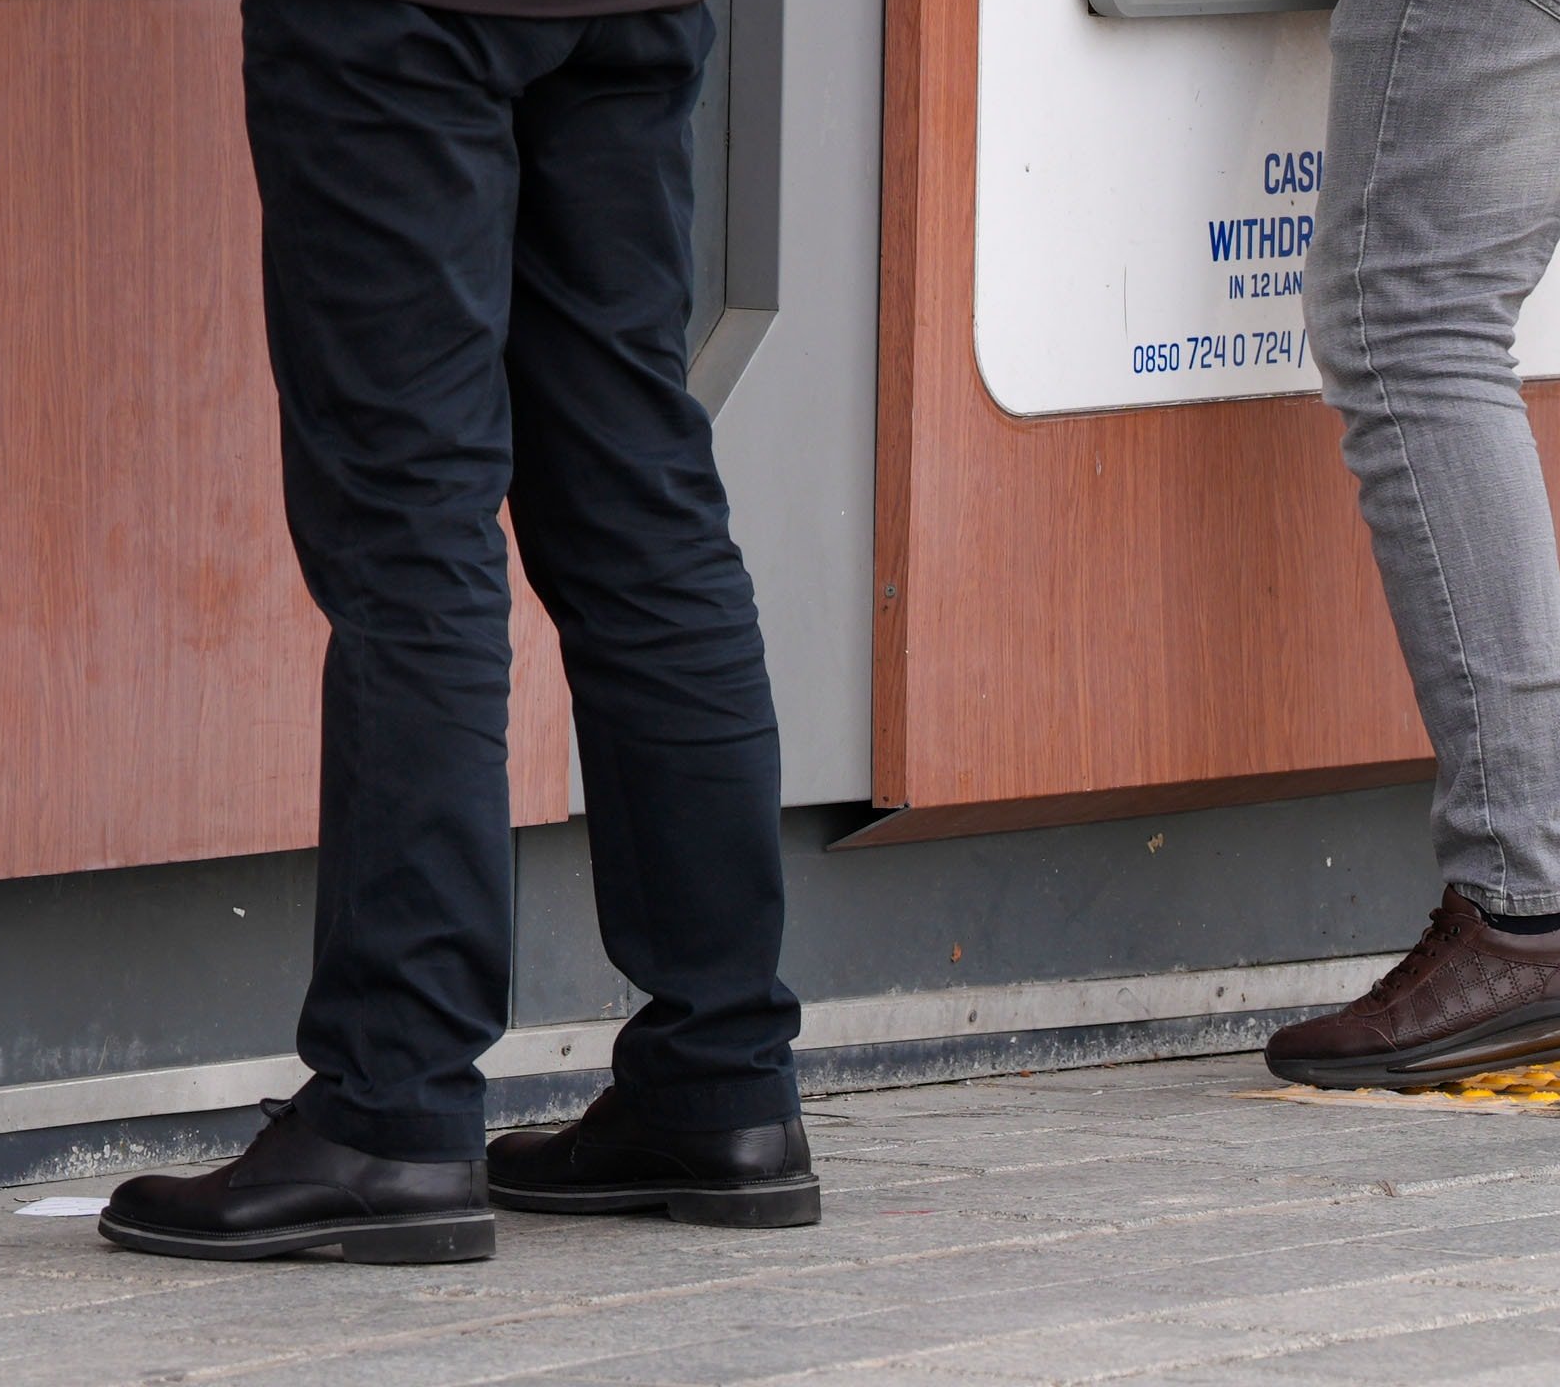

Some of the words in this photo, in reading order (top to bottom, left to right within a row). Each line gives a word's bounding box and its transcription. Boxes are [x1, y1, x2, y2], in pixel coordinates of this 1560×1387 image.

[1209, 215, 1315, 262] WITHDR
[1229, 274, 1244, 299] IN
[1251, 272, 1270, 298] 12
[1133, 343, 1179, 374] 0850
[1187, 335, 1226, 370] 724
[1233, 333, 1245, 367] 0
[1252, 330, 1291, 365] 724
